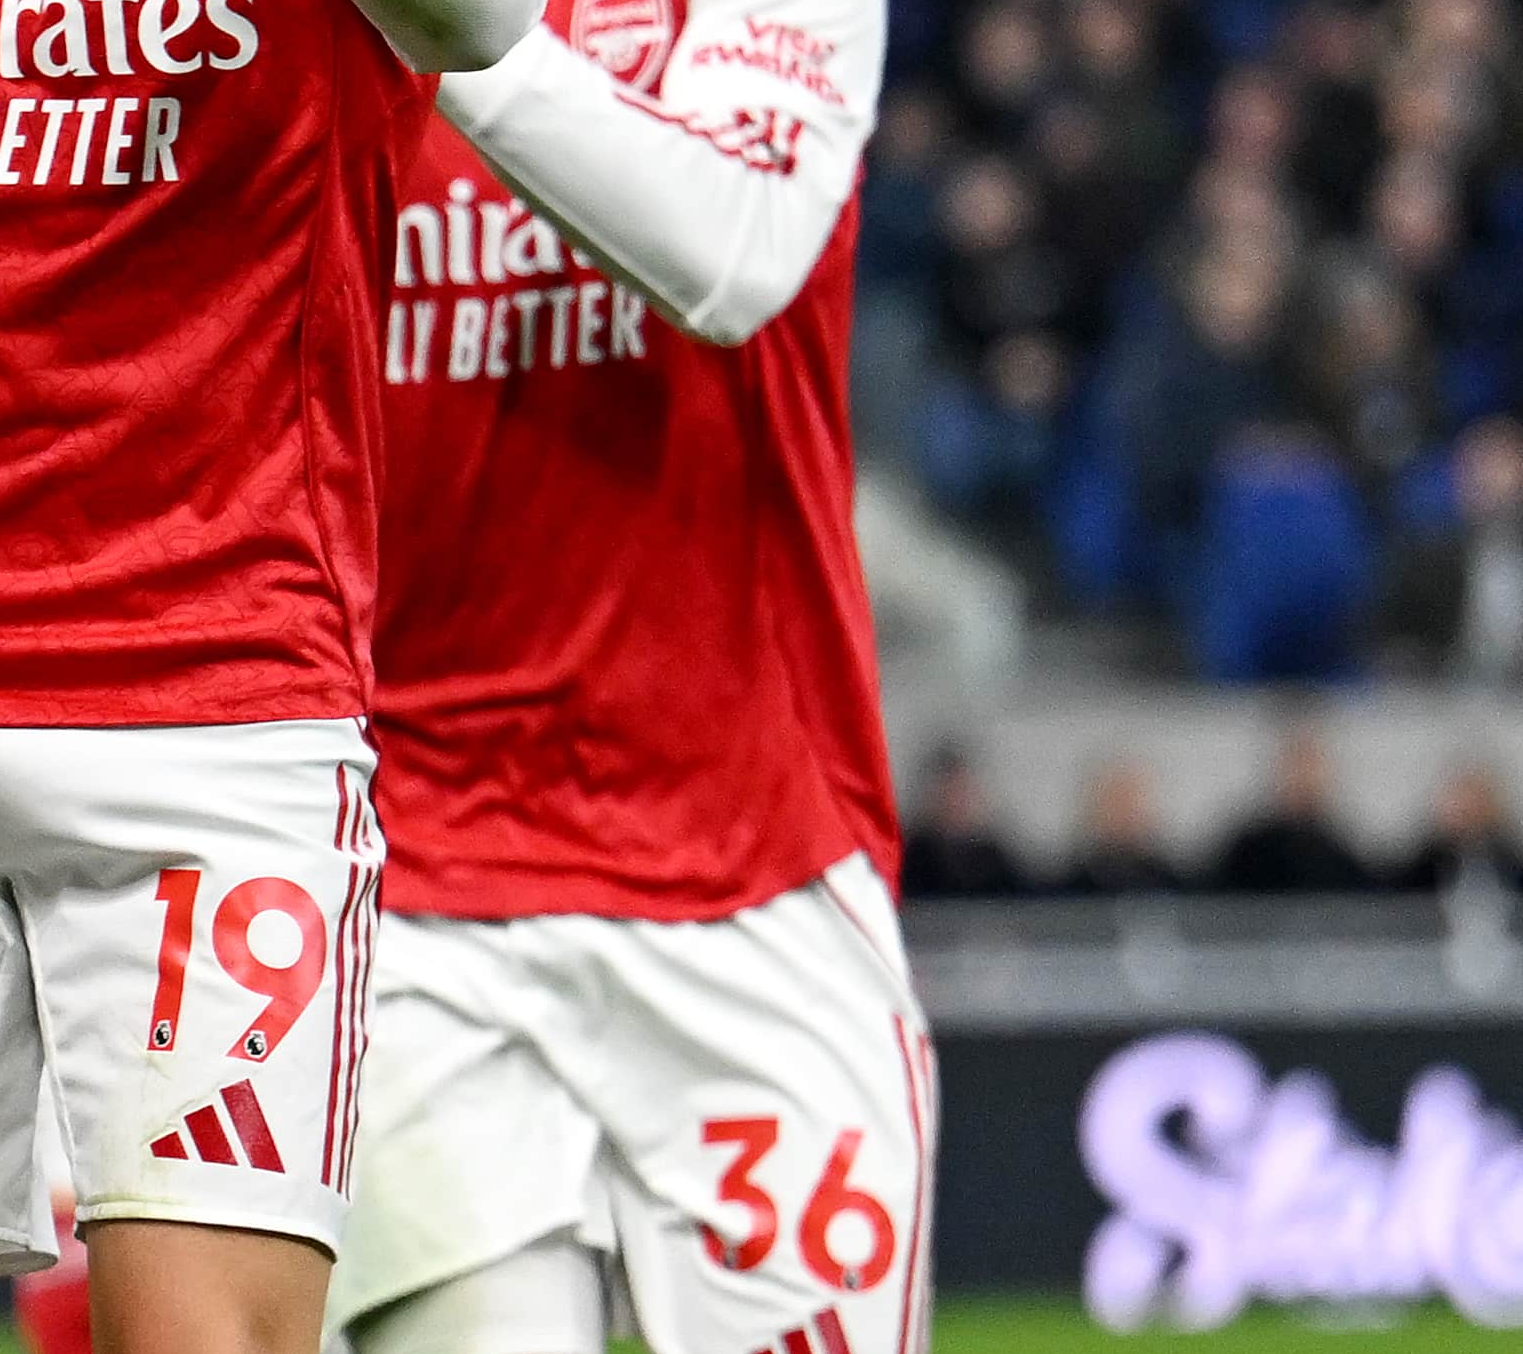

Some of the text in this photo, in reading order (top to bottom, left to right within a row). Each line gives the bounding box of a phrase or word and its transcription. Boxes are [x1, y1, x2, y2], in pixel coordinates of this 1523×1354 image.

[385, 280, 647, 385] LY BETTER
[147, 869, 328, 1063] 19
[696, 1119, 896, 1293] 36
